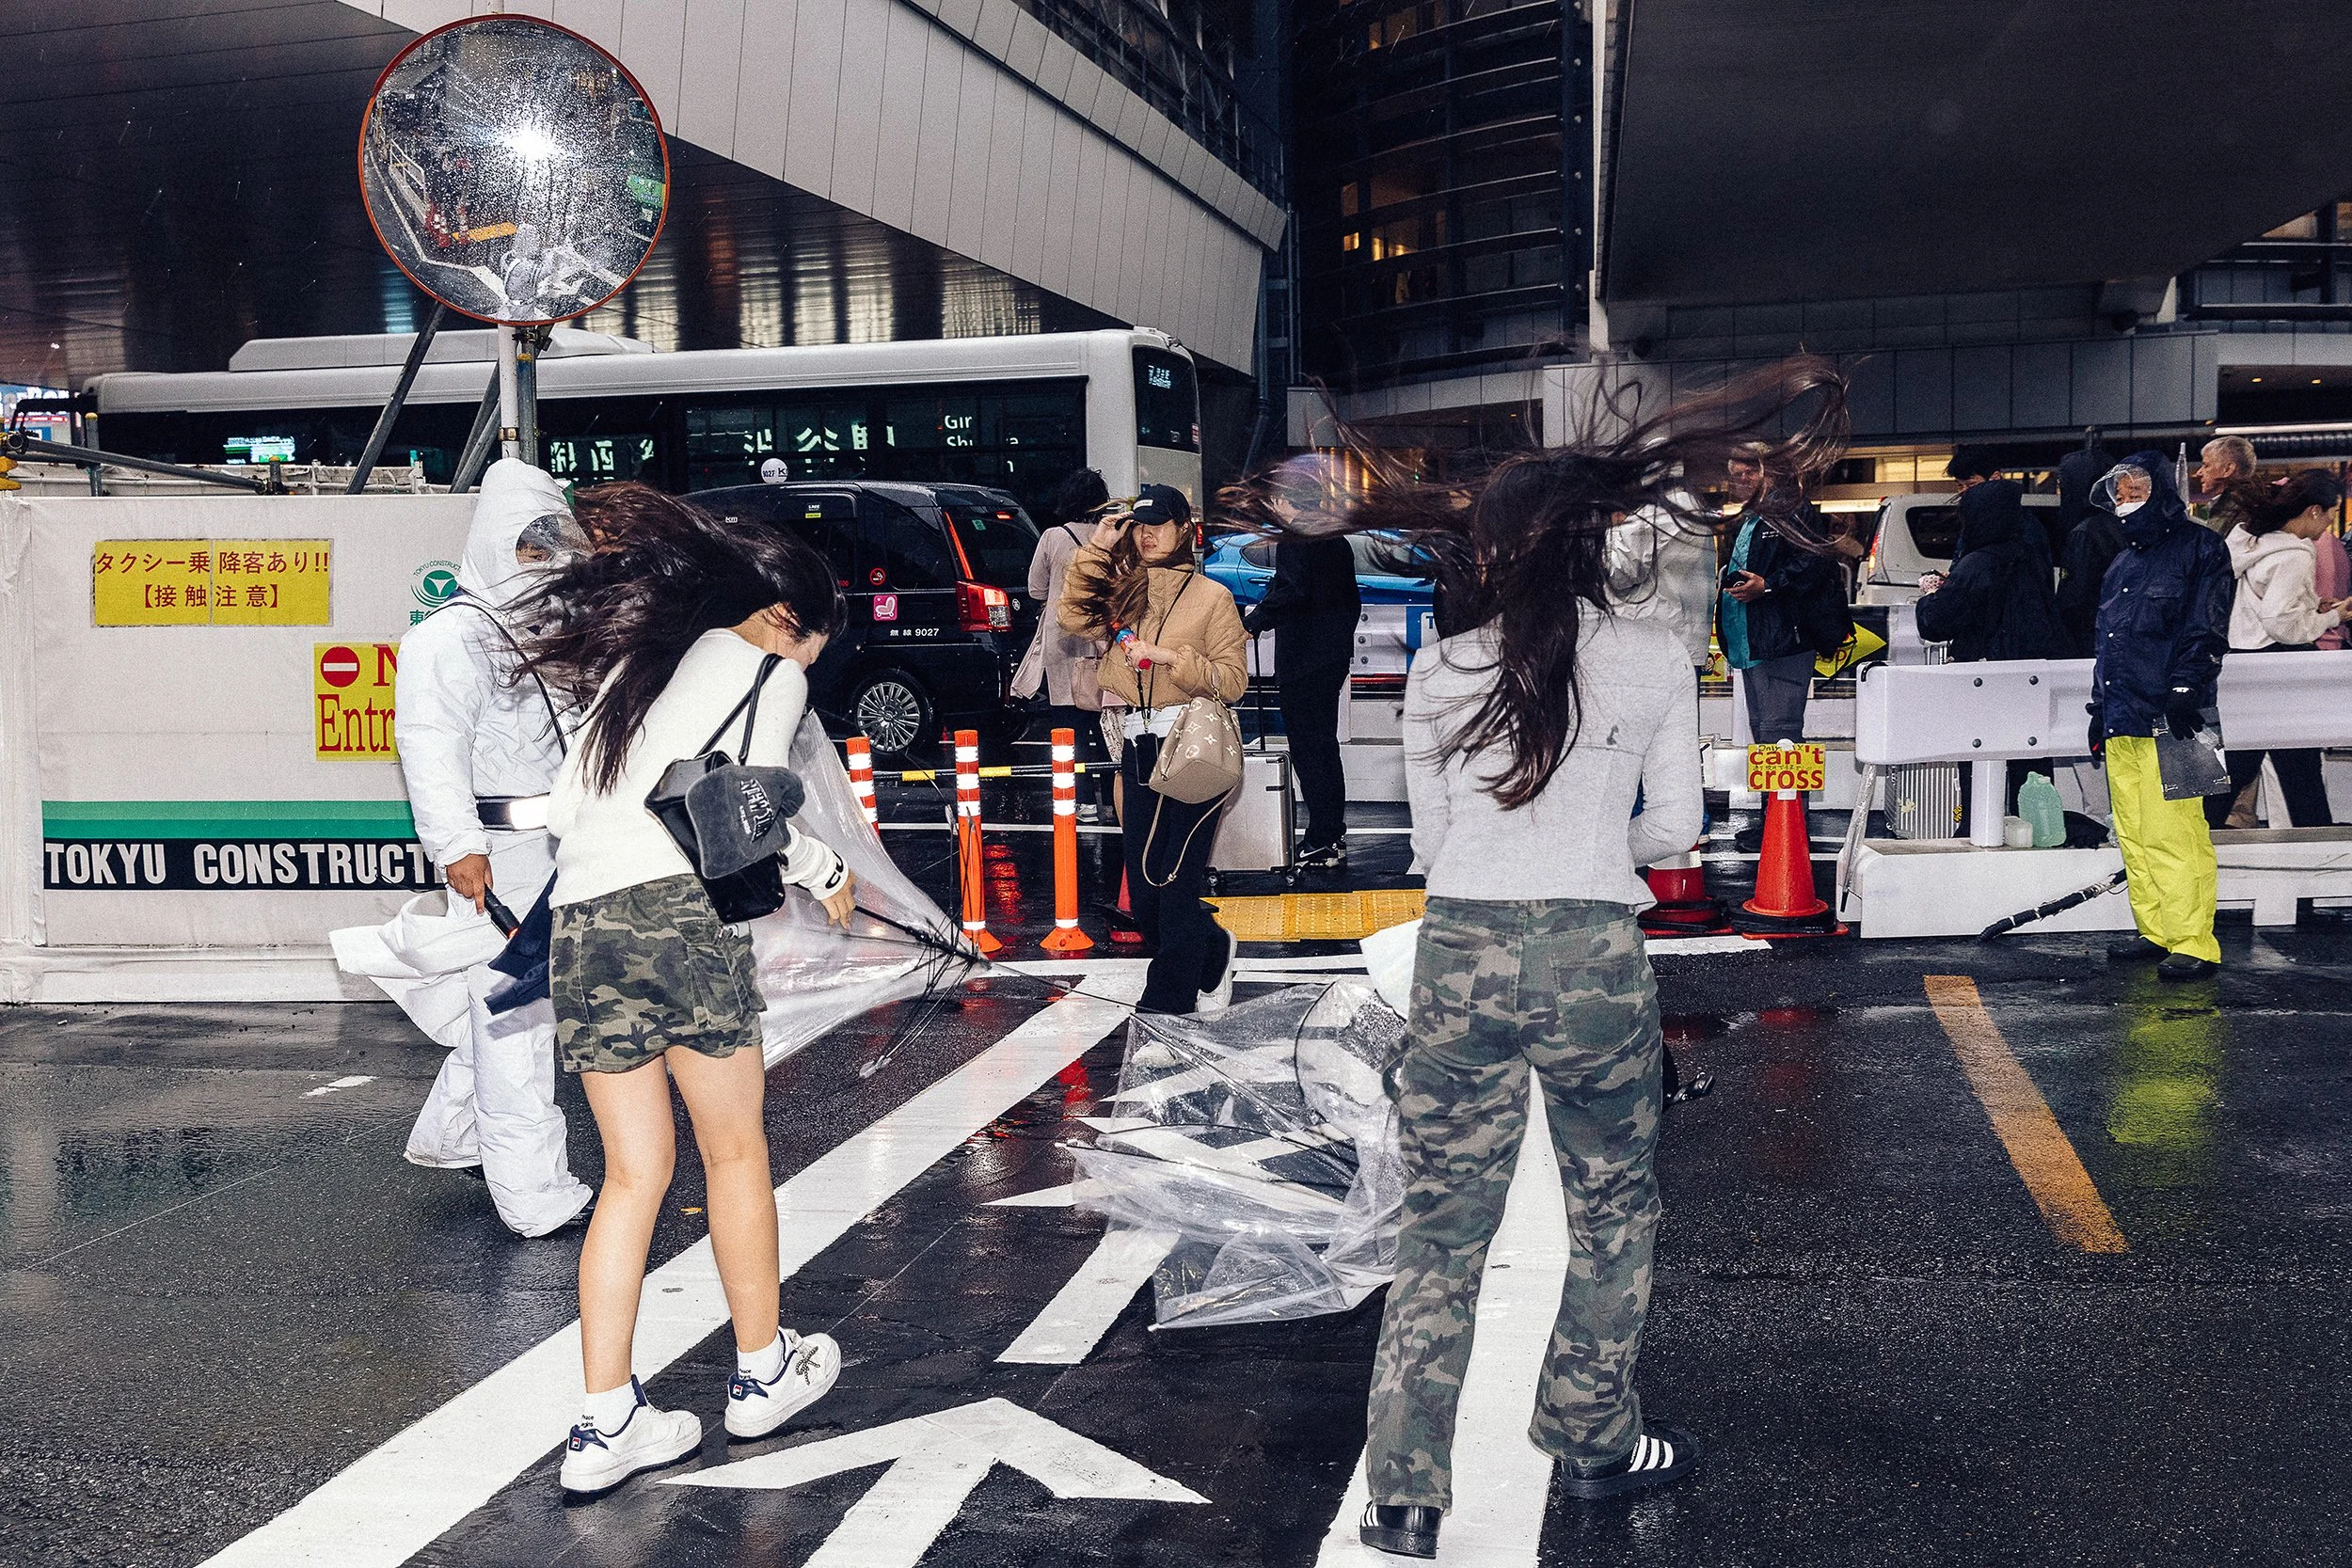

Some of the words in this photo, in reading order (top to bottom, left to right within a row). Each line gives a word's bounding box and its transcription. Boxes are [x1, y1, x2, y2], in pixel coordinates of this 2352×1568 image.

[96, 550, 329, 575] タクシー乗降客あり!!
[914, 628, 940, 637] 9027
[373, 643, 398, 687] N
[317, 693, 396, 752] Entr
[1749, 745, 1824, 765] can't
[1749, 769, 1823, 790] cross
[46, 843, 167, 884] TOKYU
